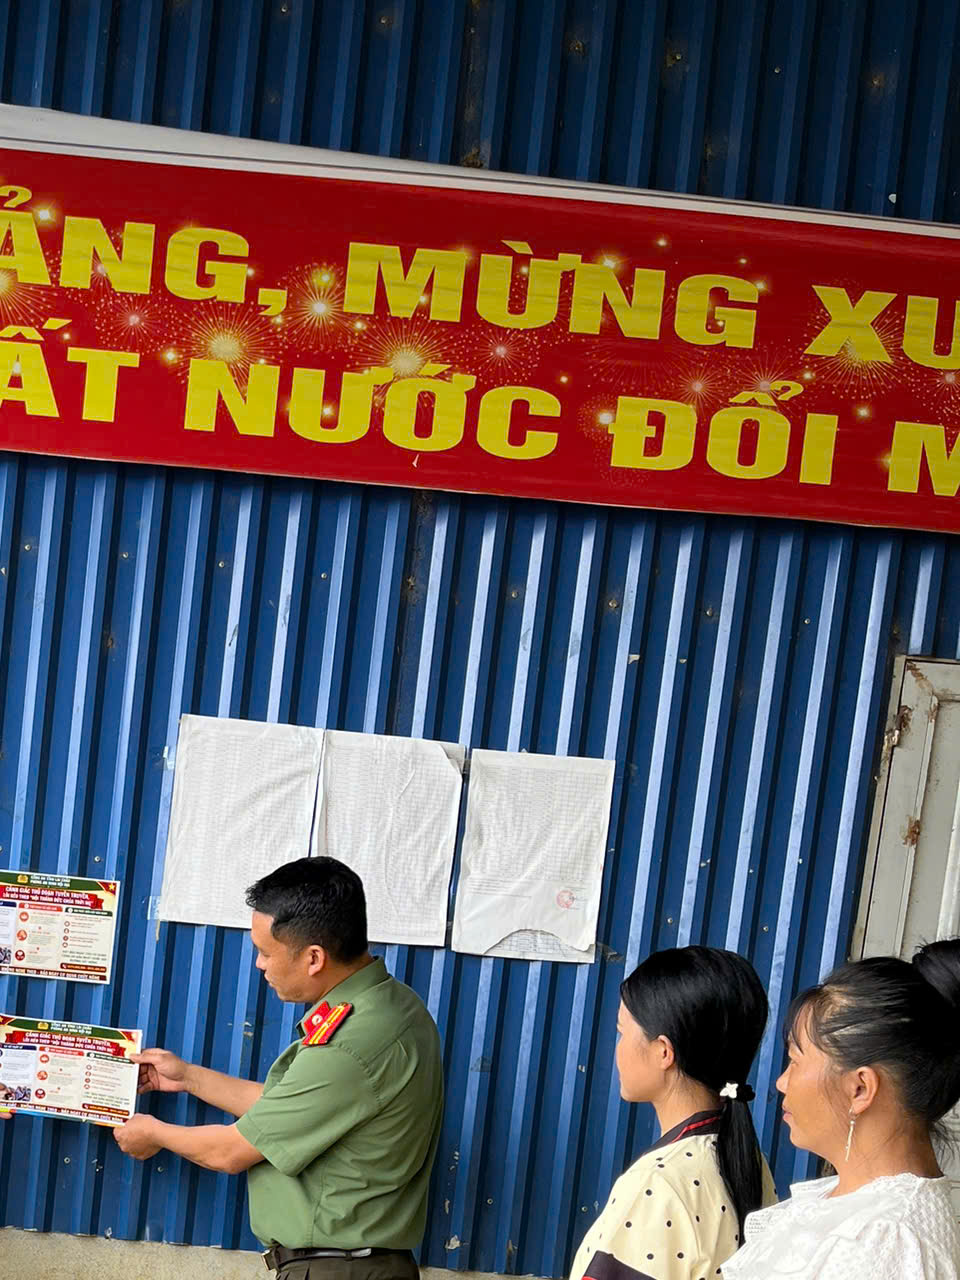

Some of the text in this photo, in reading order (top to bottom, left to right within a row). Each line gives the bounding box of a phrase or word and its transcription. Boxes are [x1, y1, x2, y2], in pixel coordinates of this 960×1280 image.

[343, 241, 759, 349] MỪNG
[184, 358, 561, 460] NƯỚC
[607, 380, 839, 486] ĐỔI
